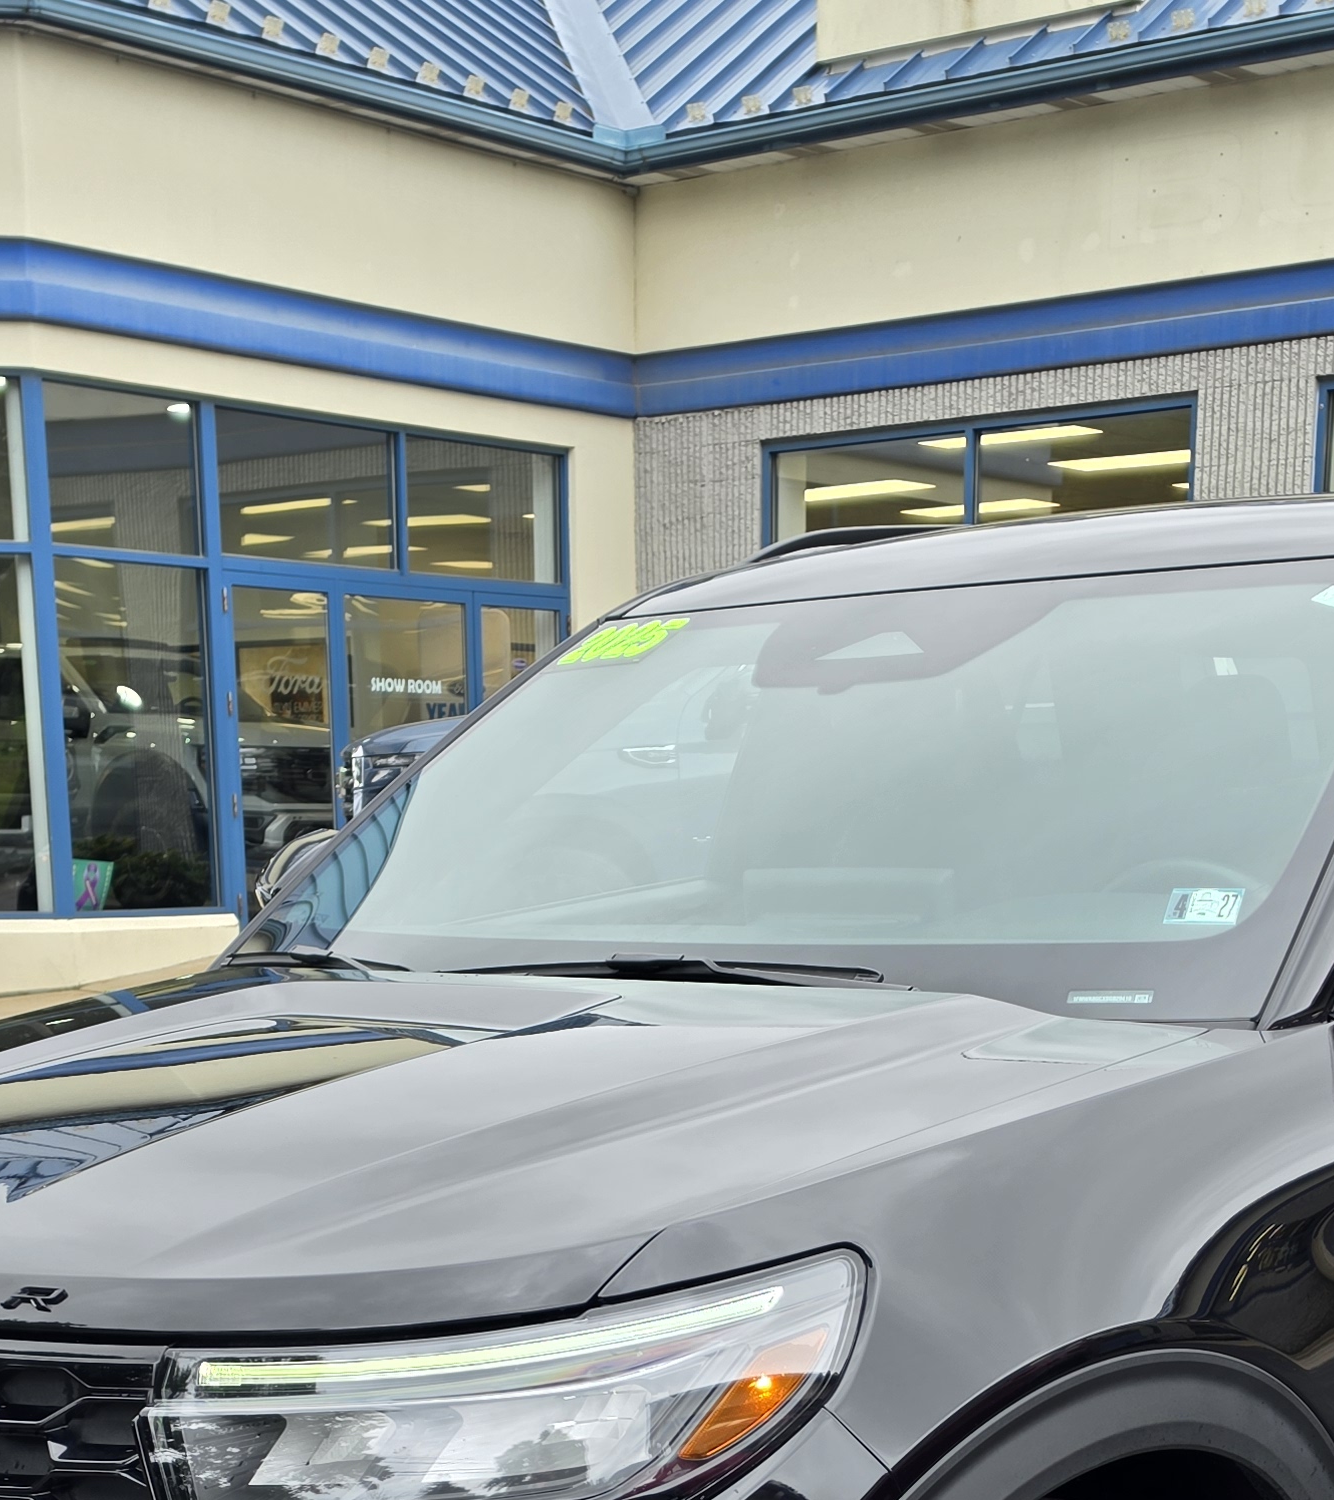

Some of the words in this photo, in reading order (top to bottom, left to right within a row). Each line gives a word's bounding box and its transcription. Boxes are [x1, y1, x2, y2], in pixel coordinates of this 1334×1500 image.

[370, 677, 405, 692] SHOW
[407, 679, 442, 694] ROOM
[1172, 893, 1189, 919] 4
[1217, 894, 1239, 919] 27
